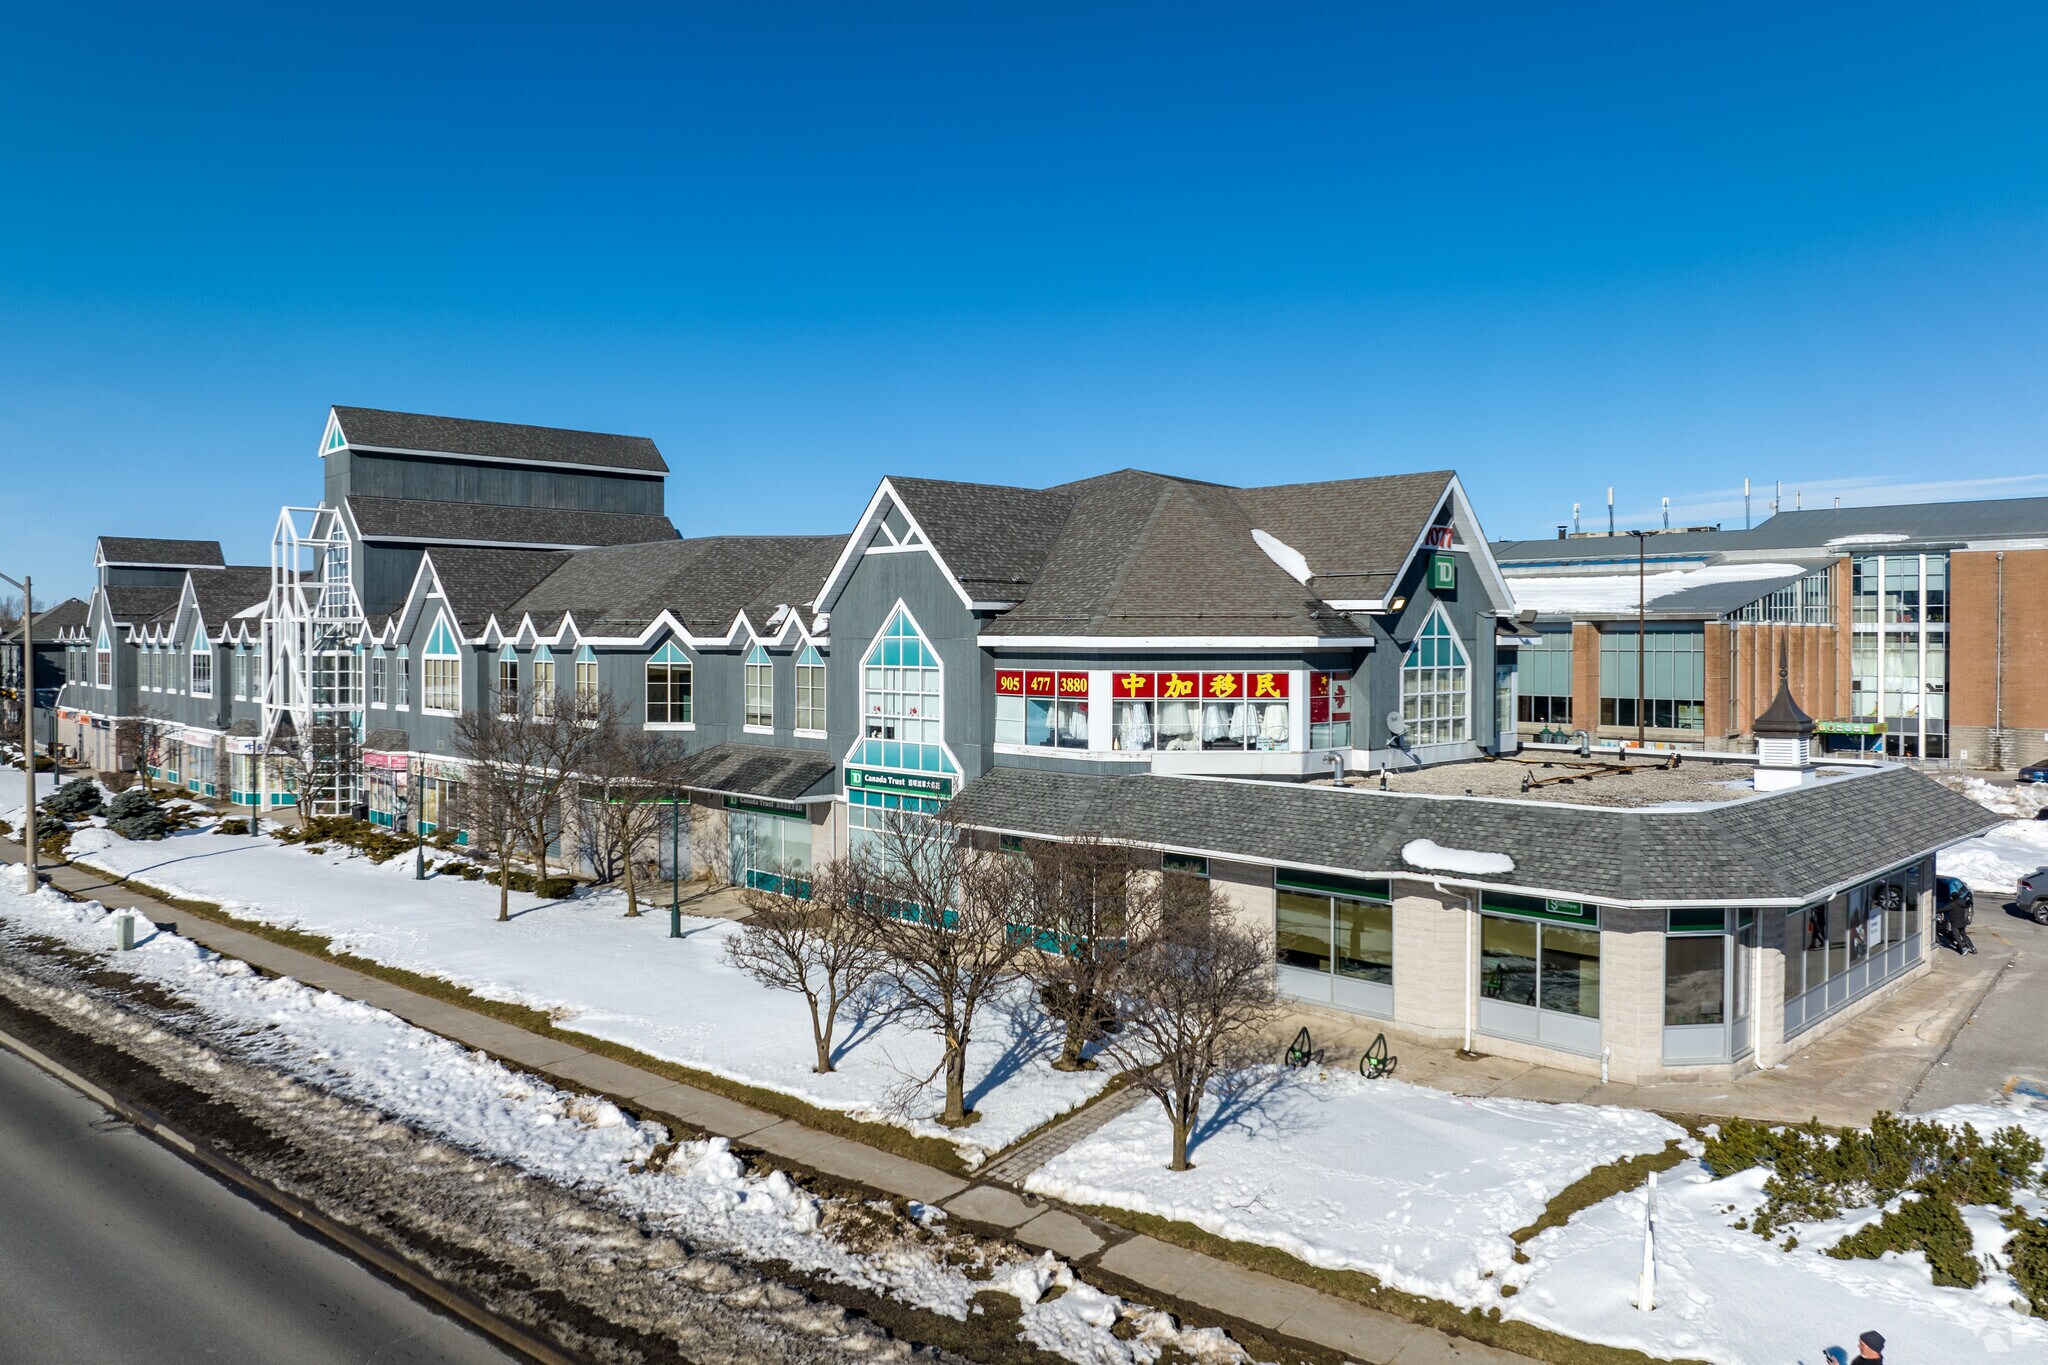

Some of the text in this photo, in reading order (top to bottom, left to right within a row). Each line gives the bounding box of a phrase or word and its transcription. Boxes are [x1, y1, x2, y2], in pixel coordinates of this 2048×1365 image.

[1437, 562, 1452, 582] TD
[1000, 676, 1088, 693] 905 477 3880
[1121, 672, 1281, 699] 中加移民
[852, 773, 861, 783] TD
[864, 774, 906, 786] Canada Trust
[740, 796, 759, 805] Canada
[760, 799, 774, 808] Trust
